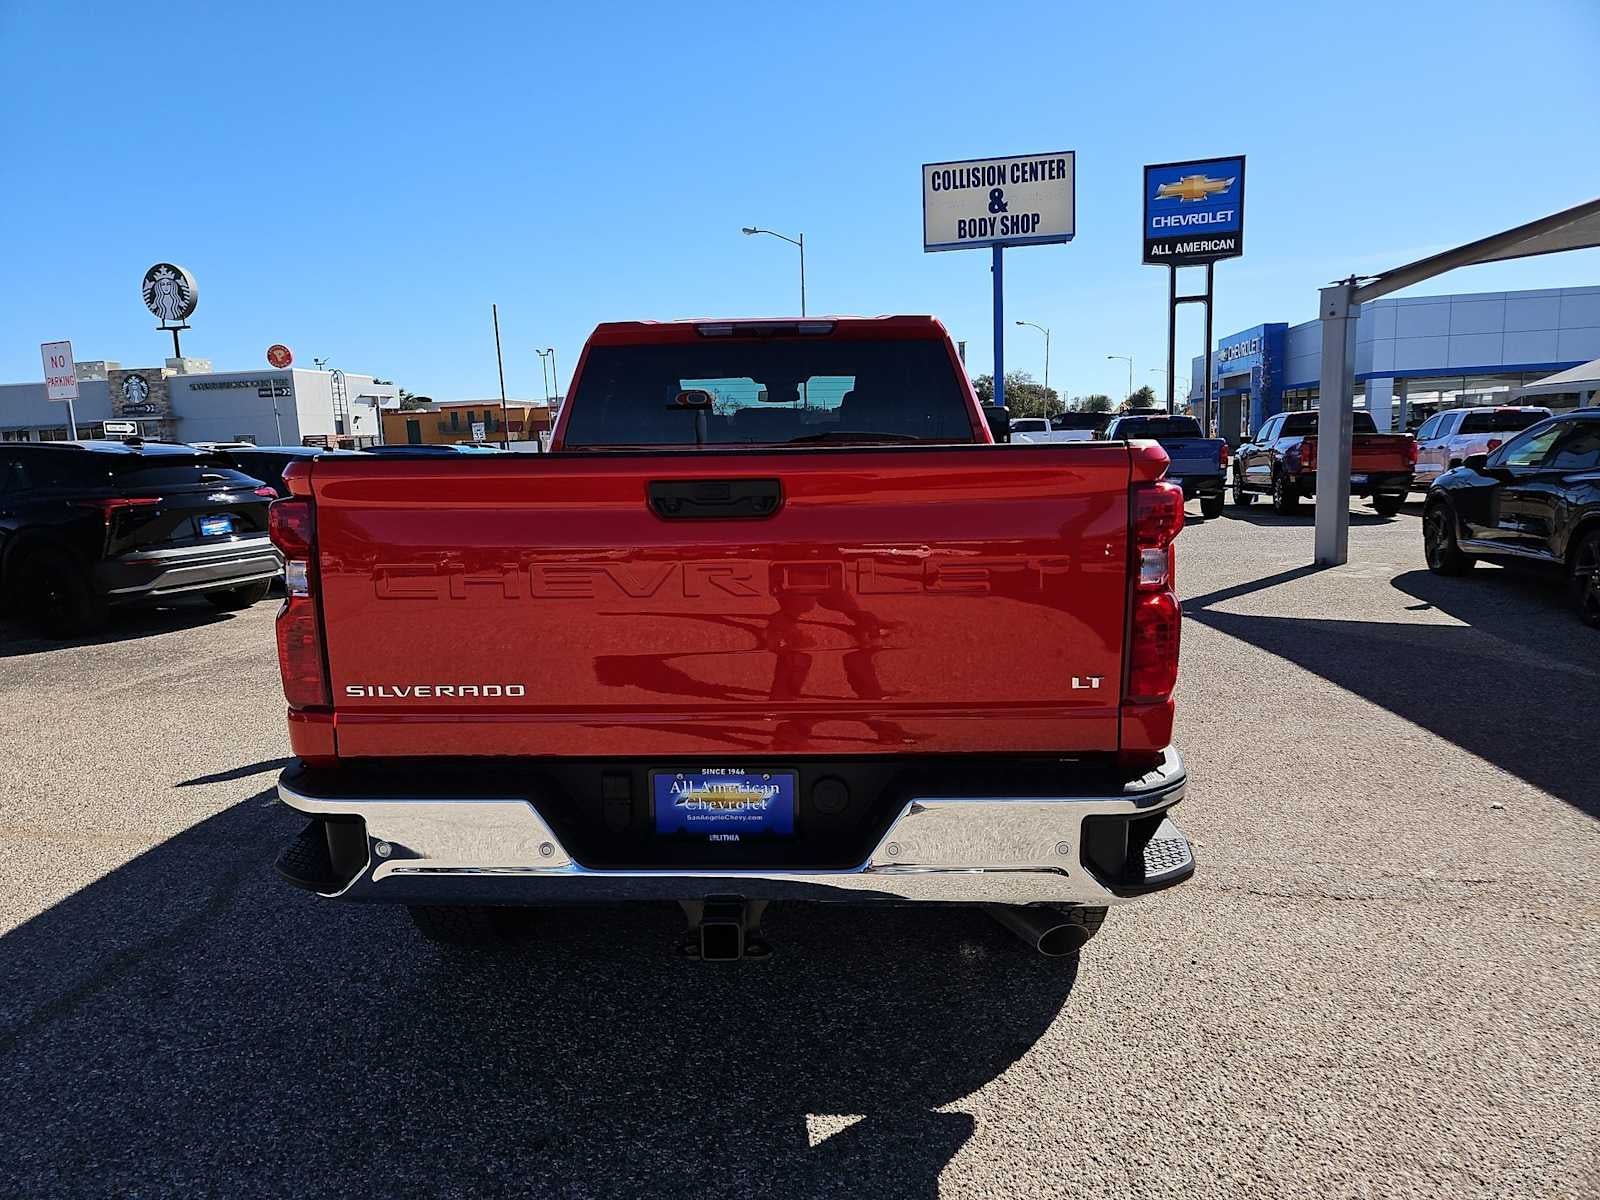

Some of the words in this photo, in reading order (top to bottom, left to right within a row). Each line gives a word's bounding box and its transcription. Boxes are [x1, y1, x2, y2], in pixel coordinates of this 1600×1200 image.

[932, 164, 1007, 191] COLLISION
[1010, 158, 1066, 184] CENTER
[988, 188, 1008, 214] &
[957, 217, 997, 239] BODY
[1000, 213, 1040, 236] SHOP
[1152, 210, 1234, 228] CHEVROLET
[1151, 244, 1172, 256] ALL
[1175, 239, 1235, 254] AMERICAN
[50, 355, 65, 369] NO
[47, 375, 75, 388] PARKING
[374, 555, 1070, 600] CHEVROLET
[1071, 675, 1104, 690] LT
[345, 684, 526, 698] SILVERADO
[702, 768, 725, 776] SINCE
[728, 768, 745, 776] 1946
[670, 781, 693, 794] All
[700, 780, 780, 794] American
[685, 797, 768, 810] Chevrolet
